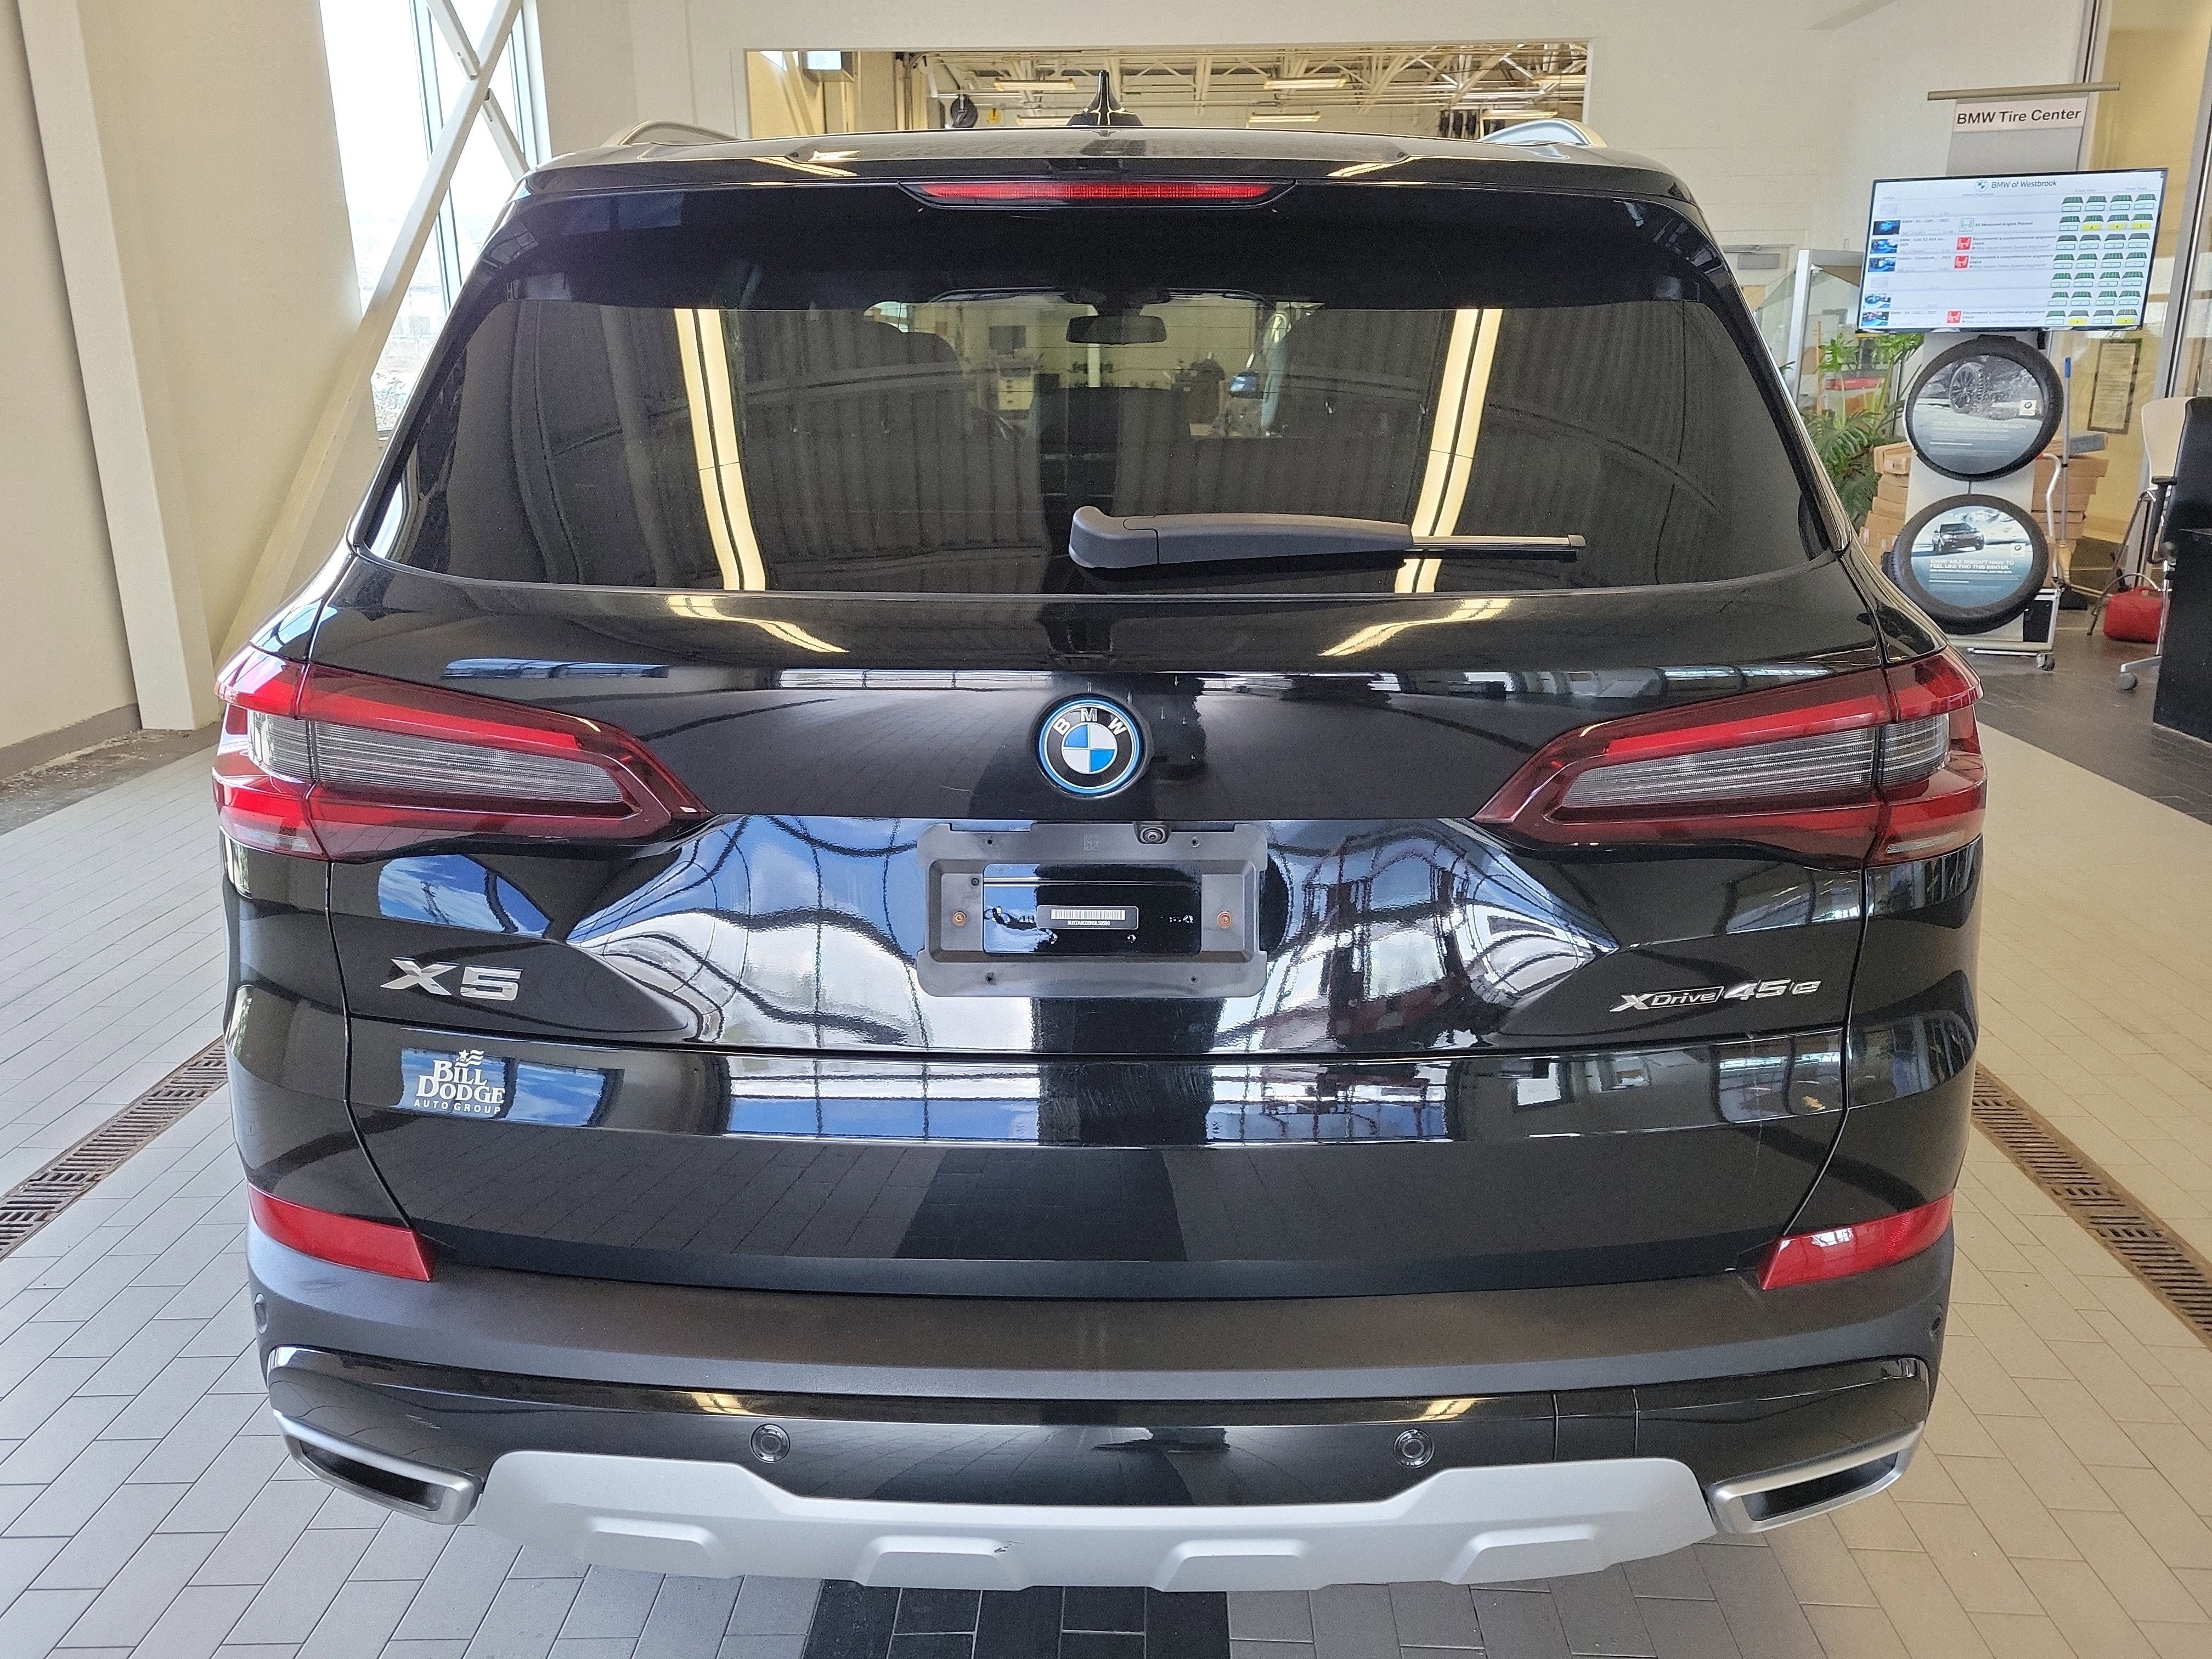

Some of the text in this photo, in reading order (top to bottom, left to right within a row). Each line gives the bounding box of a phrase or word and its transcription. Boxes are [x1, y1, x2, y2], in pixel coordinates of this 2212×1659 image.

[1957, 109, 2081, 124] BMW Tire Center
[1053, 708, 1127, 736] BMW
[380, 957, 523, 1001] X5
[433, 1059, 488, 1086] BILL
[415, 1075, 505, 1104] DODGE
[414, 1099, 502, 1114] AUTO GROUP
